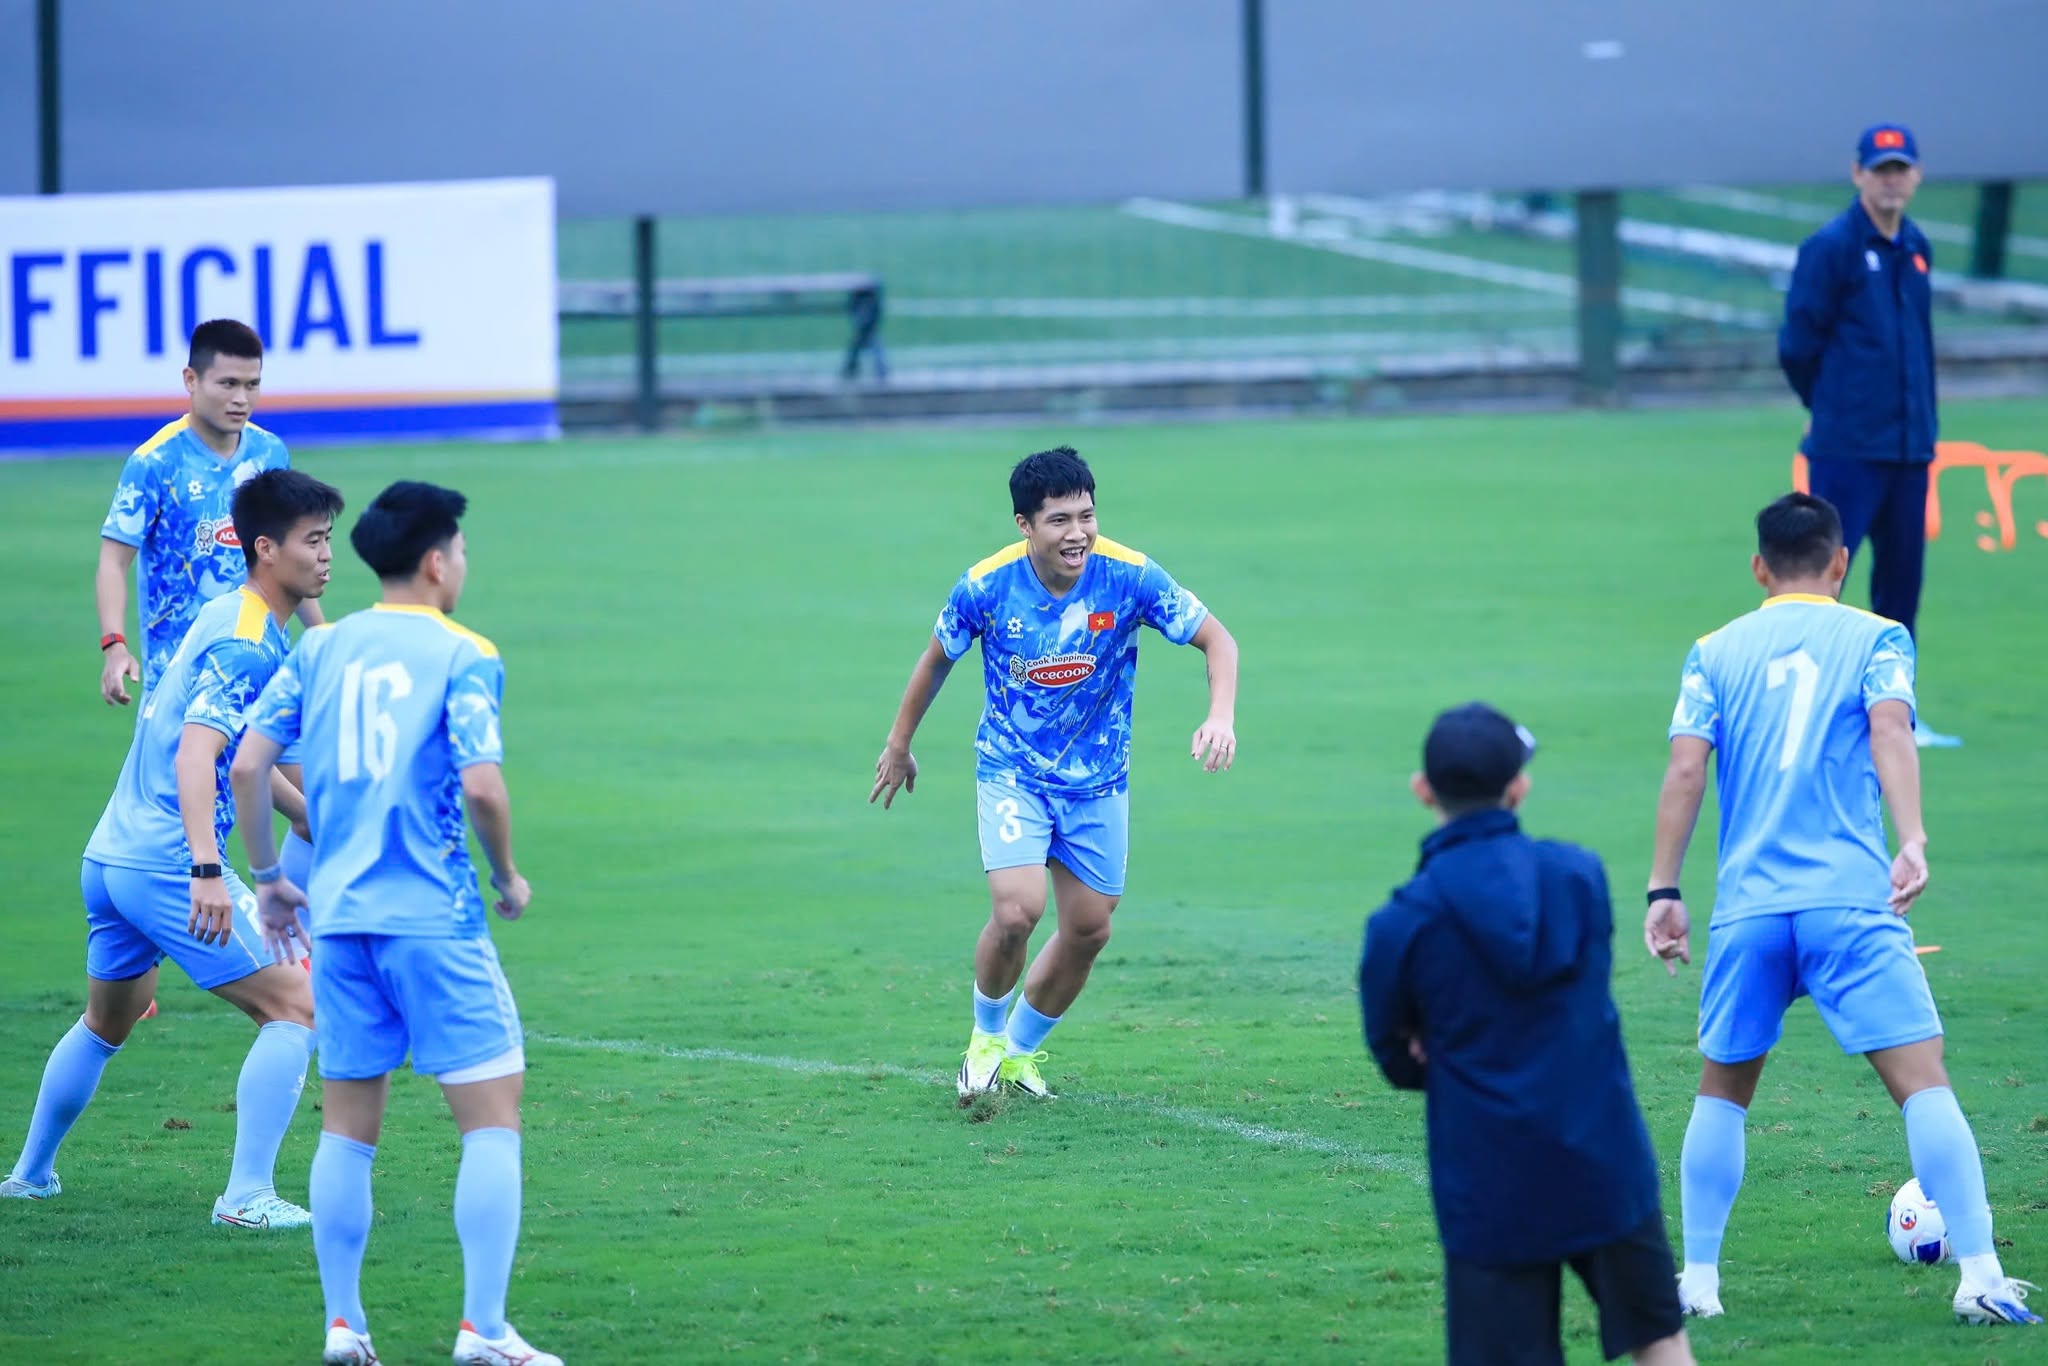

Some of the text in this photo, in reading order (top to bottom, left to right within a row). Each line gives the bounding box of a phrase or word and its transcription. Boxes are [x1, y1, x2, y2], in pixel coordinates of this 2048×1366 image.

[0, 240, 421, 361] FFICIAL
[337, 658, 413, 784] 16
[1027, 653, 1095, 668] Cook happiness
[1766, 649, 1820, 772] 7
[995, 798, 1022, 844] 3
